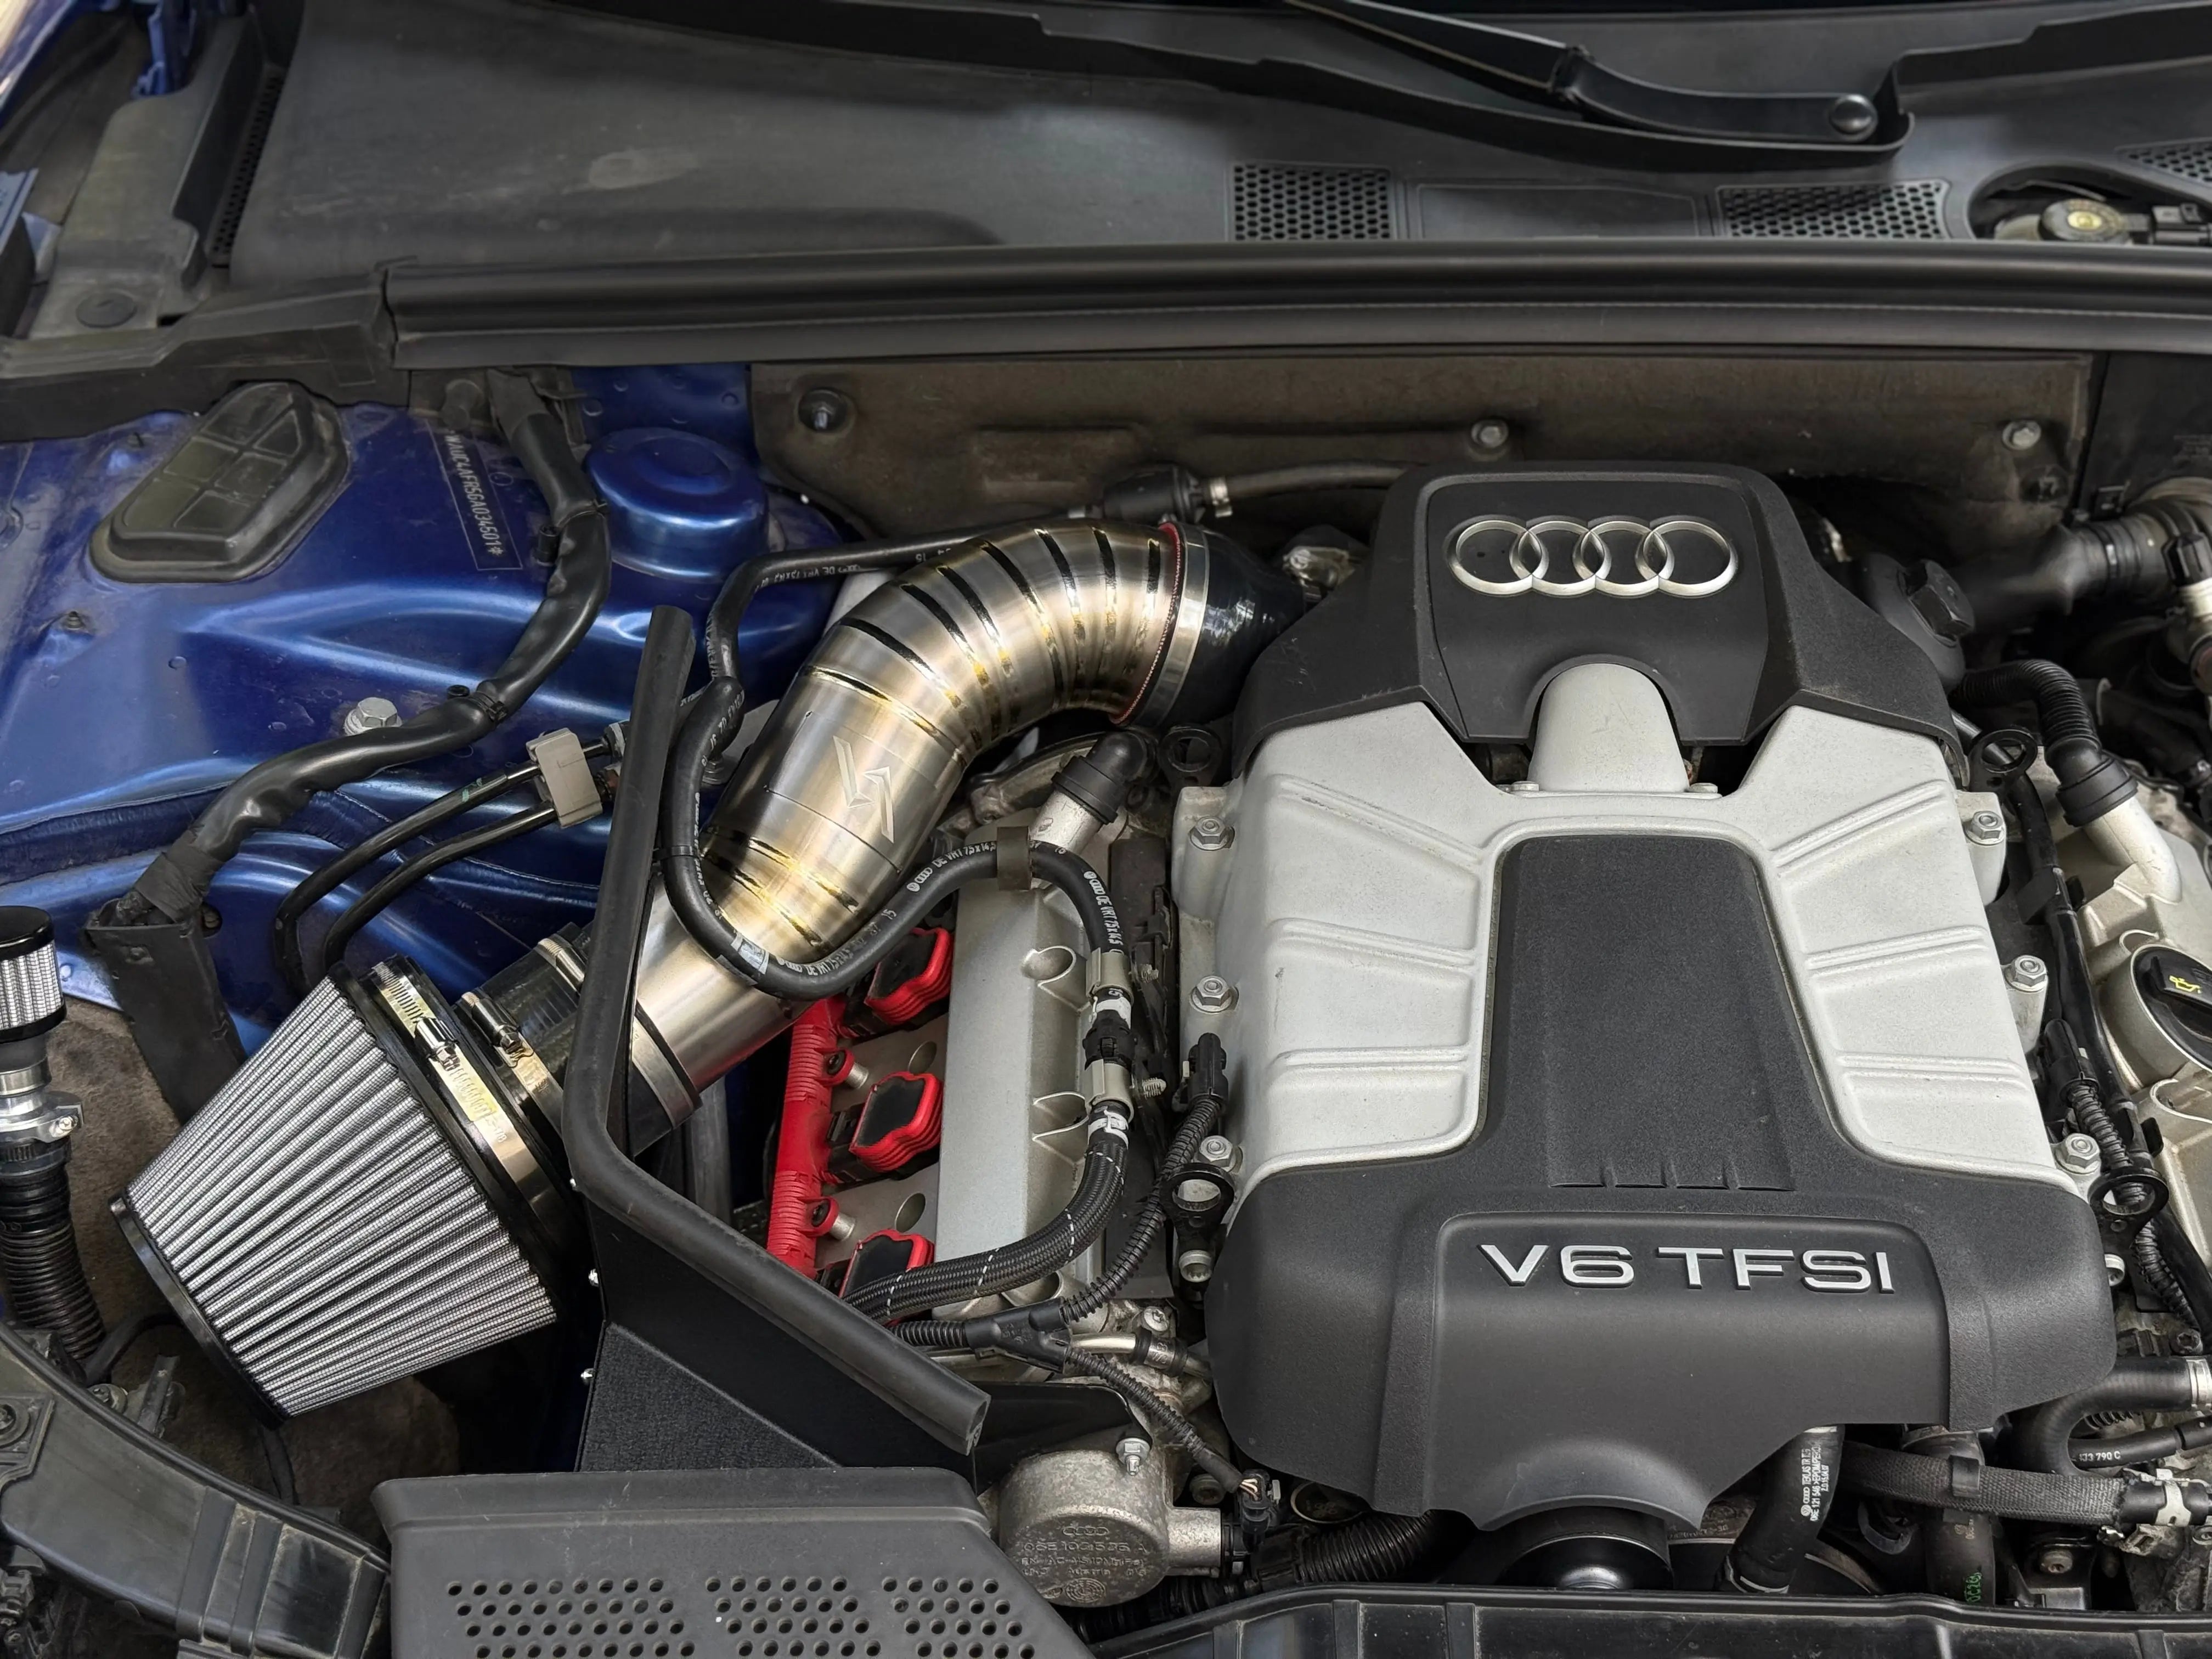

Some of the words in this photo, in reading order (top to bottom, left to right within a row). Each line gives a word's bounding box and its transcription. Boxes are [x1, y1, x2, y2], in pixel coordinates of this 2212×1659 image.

[932, 857, 947, 868] DE
[946, 849, 963, 861] VRT
[1096, 896, 1113, 906] DE
[1100, 906, 1117, 919] VRT
[805, 965, 818, 976] DE
[1480, 1244, 1634, 1287] V6
[1657, 1246, 1895, 1294] TFSI
[2095, 1452, 2113, 1461] 790
[2114, 1451, 2121, 1459] C
